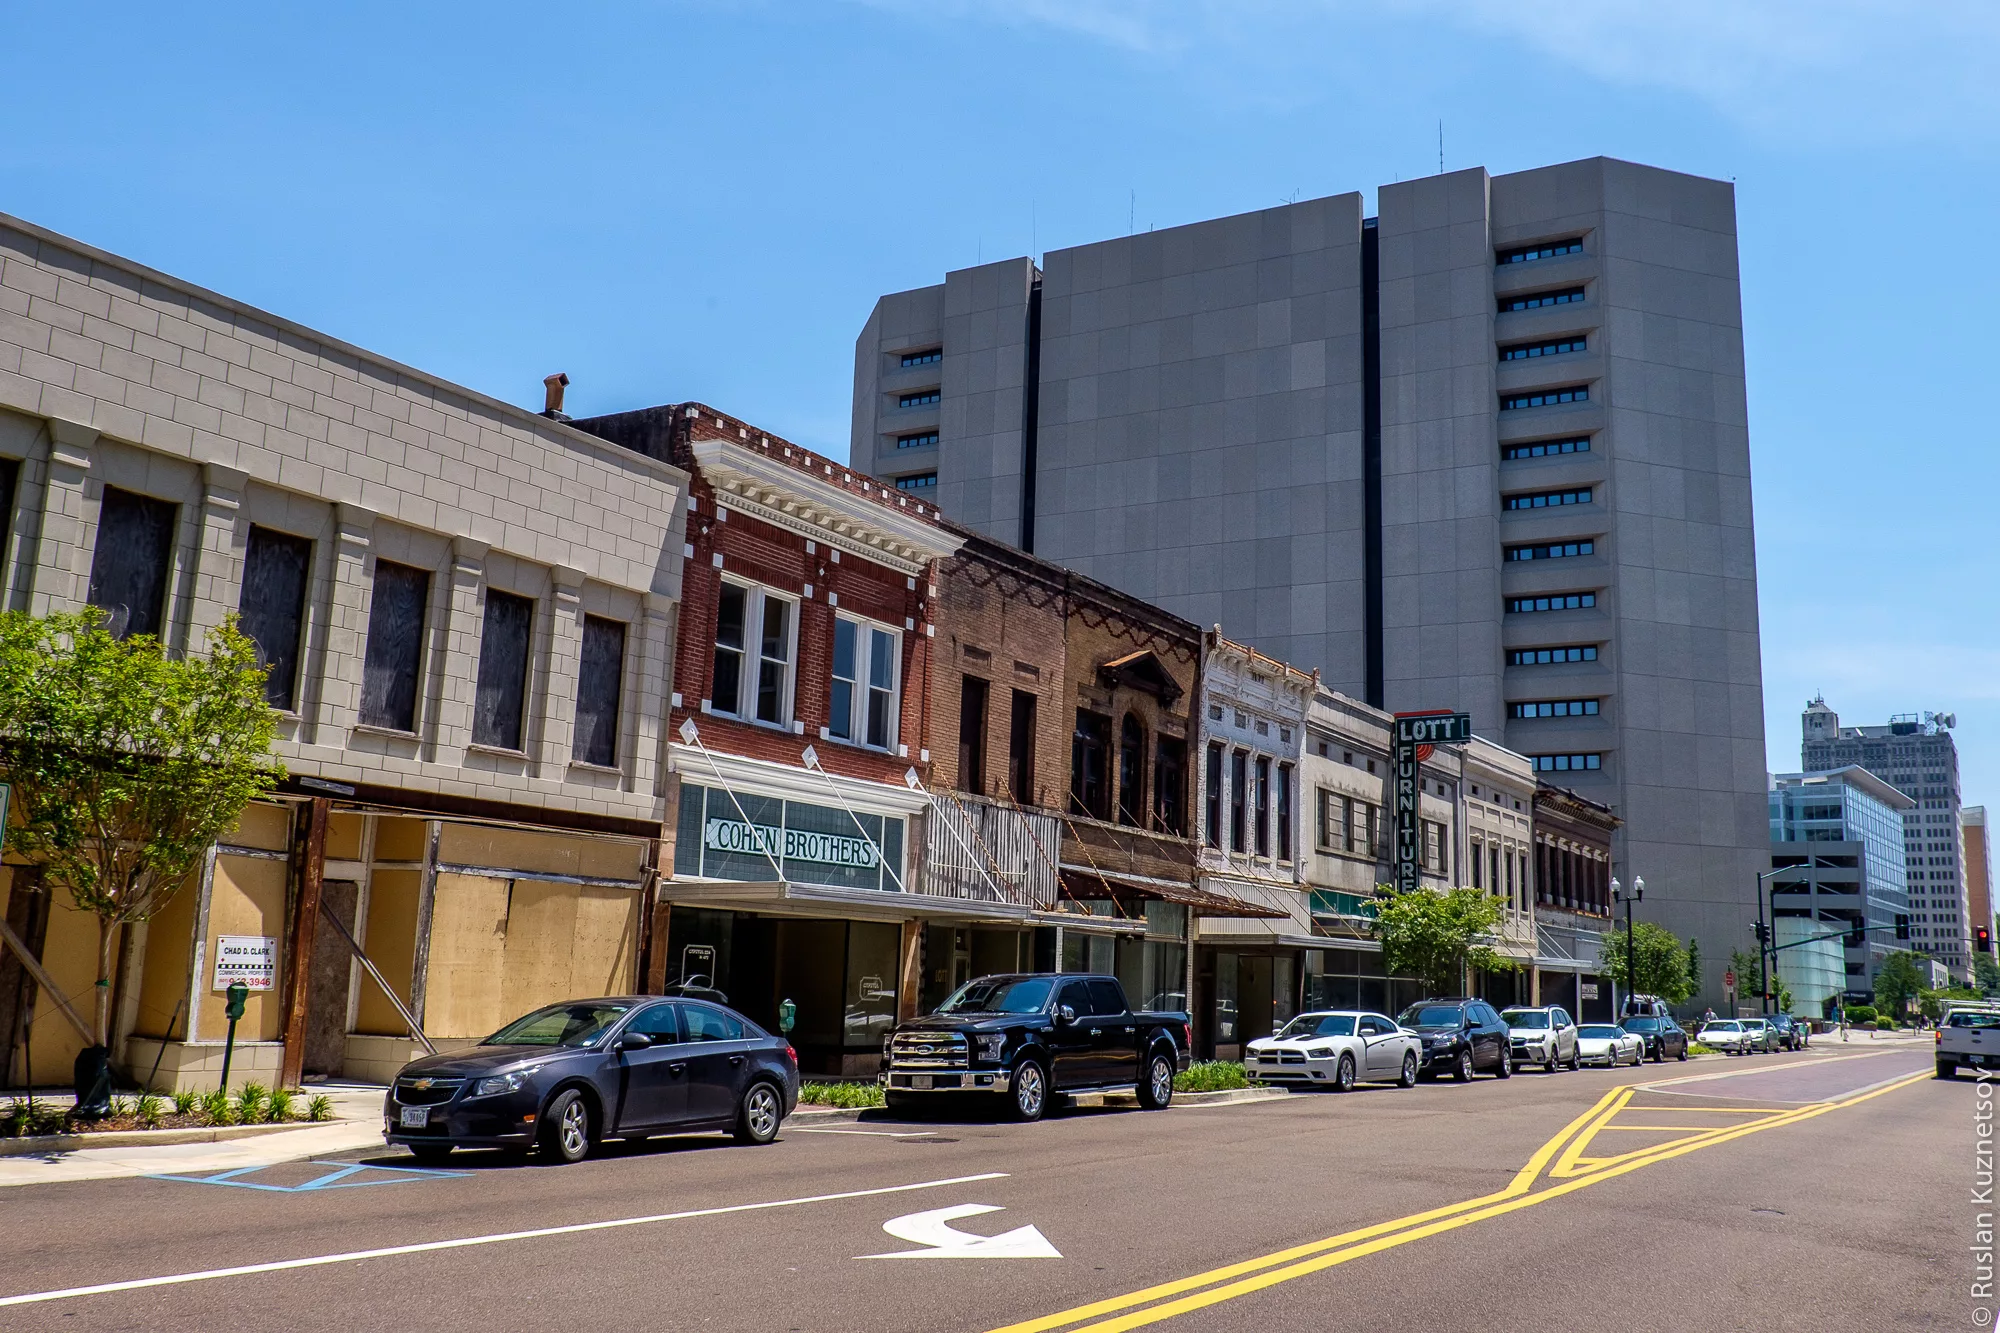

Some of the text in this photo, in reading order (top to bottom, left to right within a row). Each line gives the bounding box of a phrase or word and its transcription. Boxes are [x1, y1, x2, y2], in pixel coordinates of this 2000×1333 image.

[1400, 718, 1455, 741] LOTT
[1400, 746, 1415, 894] FURNITURE
[718, 822, 871, 865] COHEN BROTHERS
[224, 947, 241, 955] CHAD
